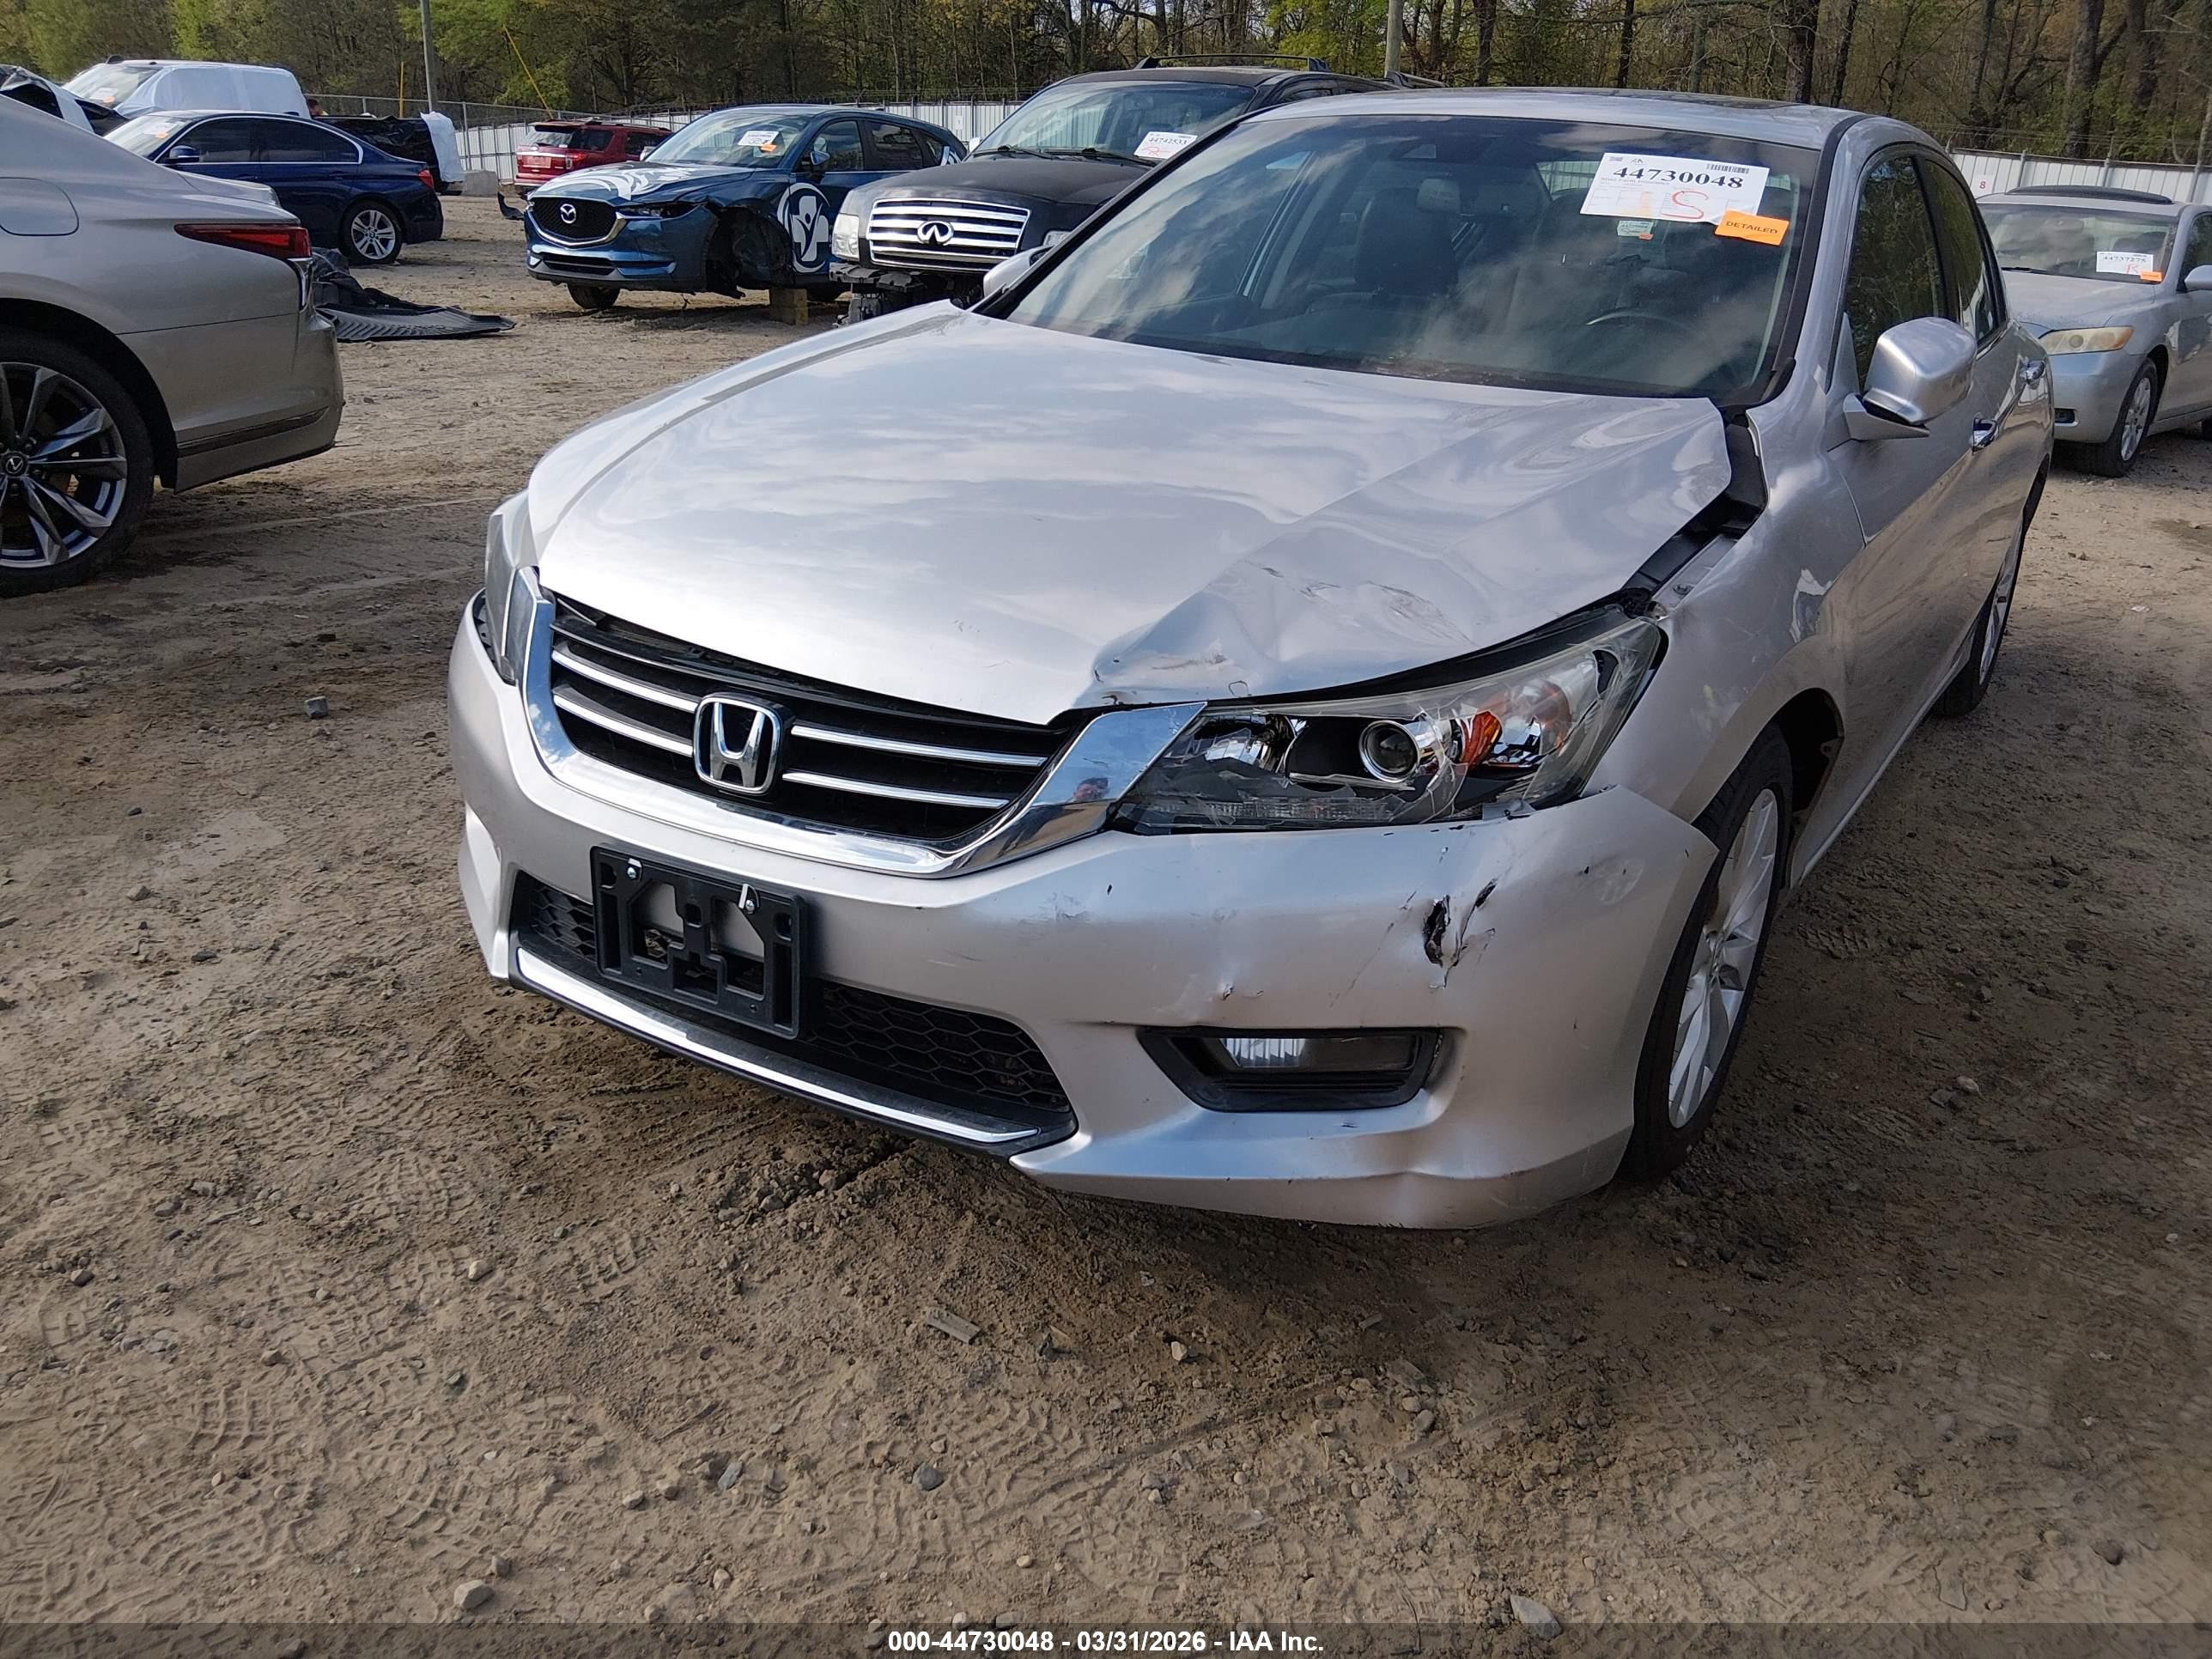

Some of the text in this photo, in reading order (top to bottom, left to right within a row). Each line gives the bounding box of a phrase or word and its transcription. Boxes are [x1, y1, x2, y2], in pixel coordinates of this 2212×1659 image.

[1613, 167, 1744, 189] 44730048
[1978, 180, 1986, 190] 8
[1661, 191, 1709, 220] S
[1725, 221, 1778, 234] DETAILED
